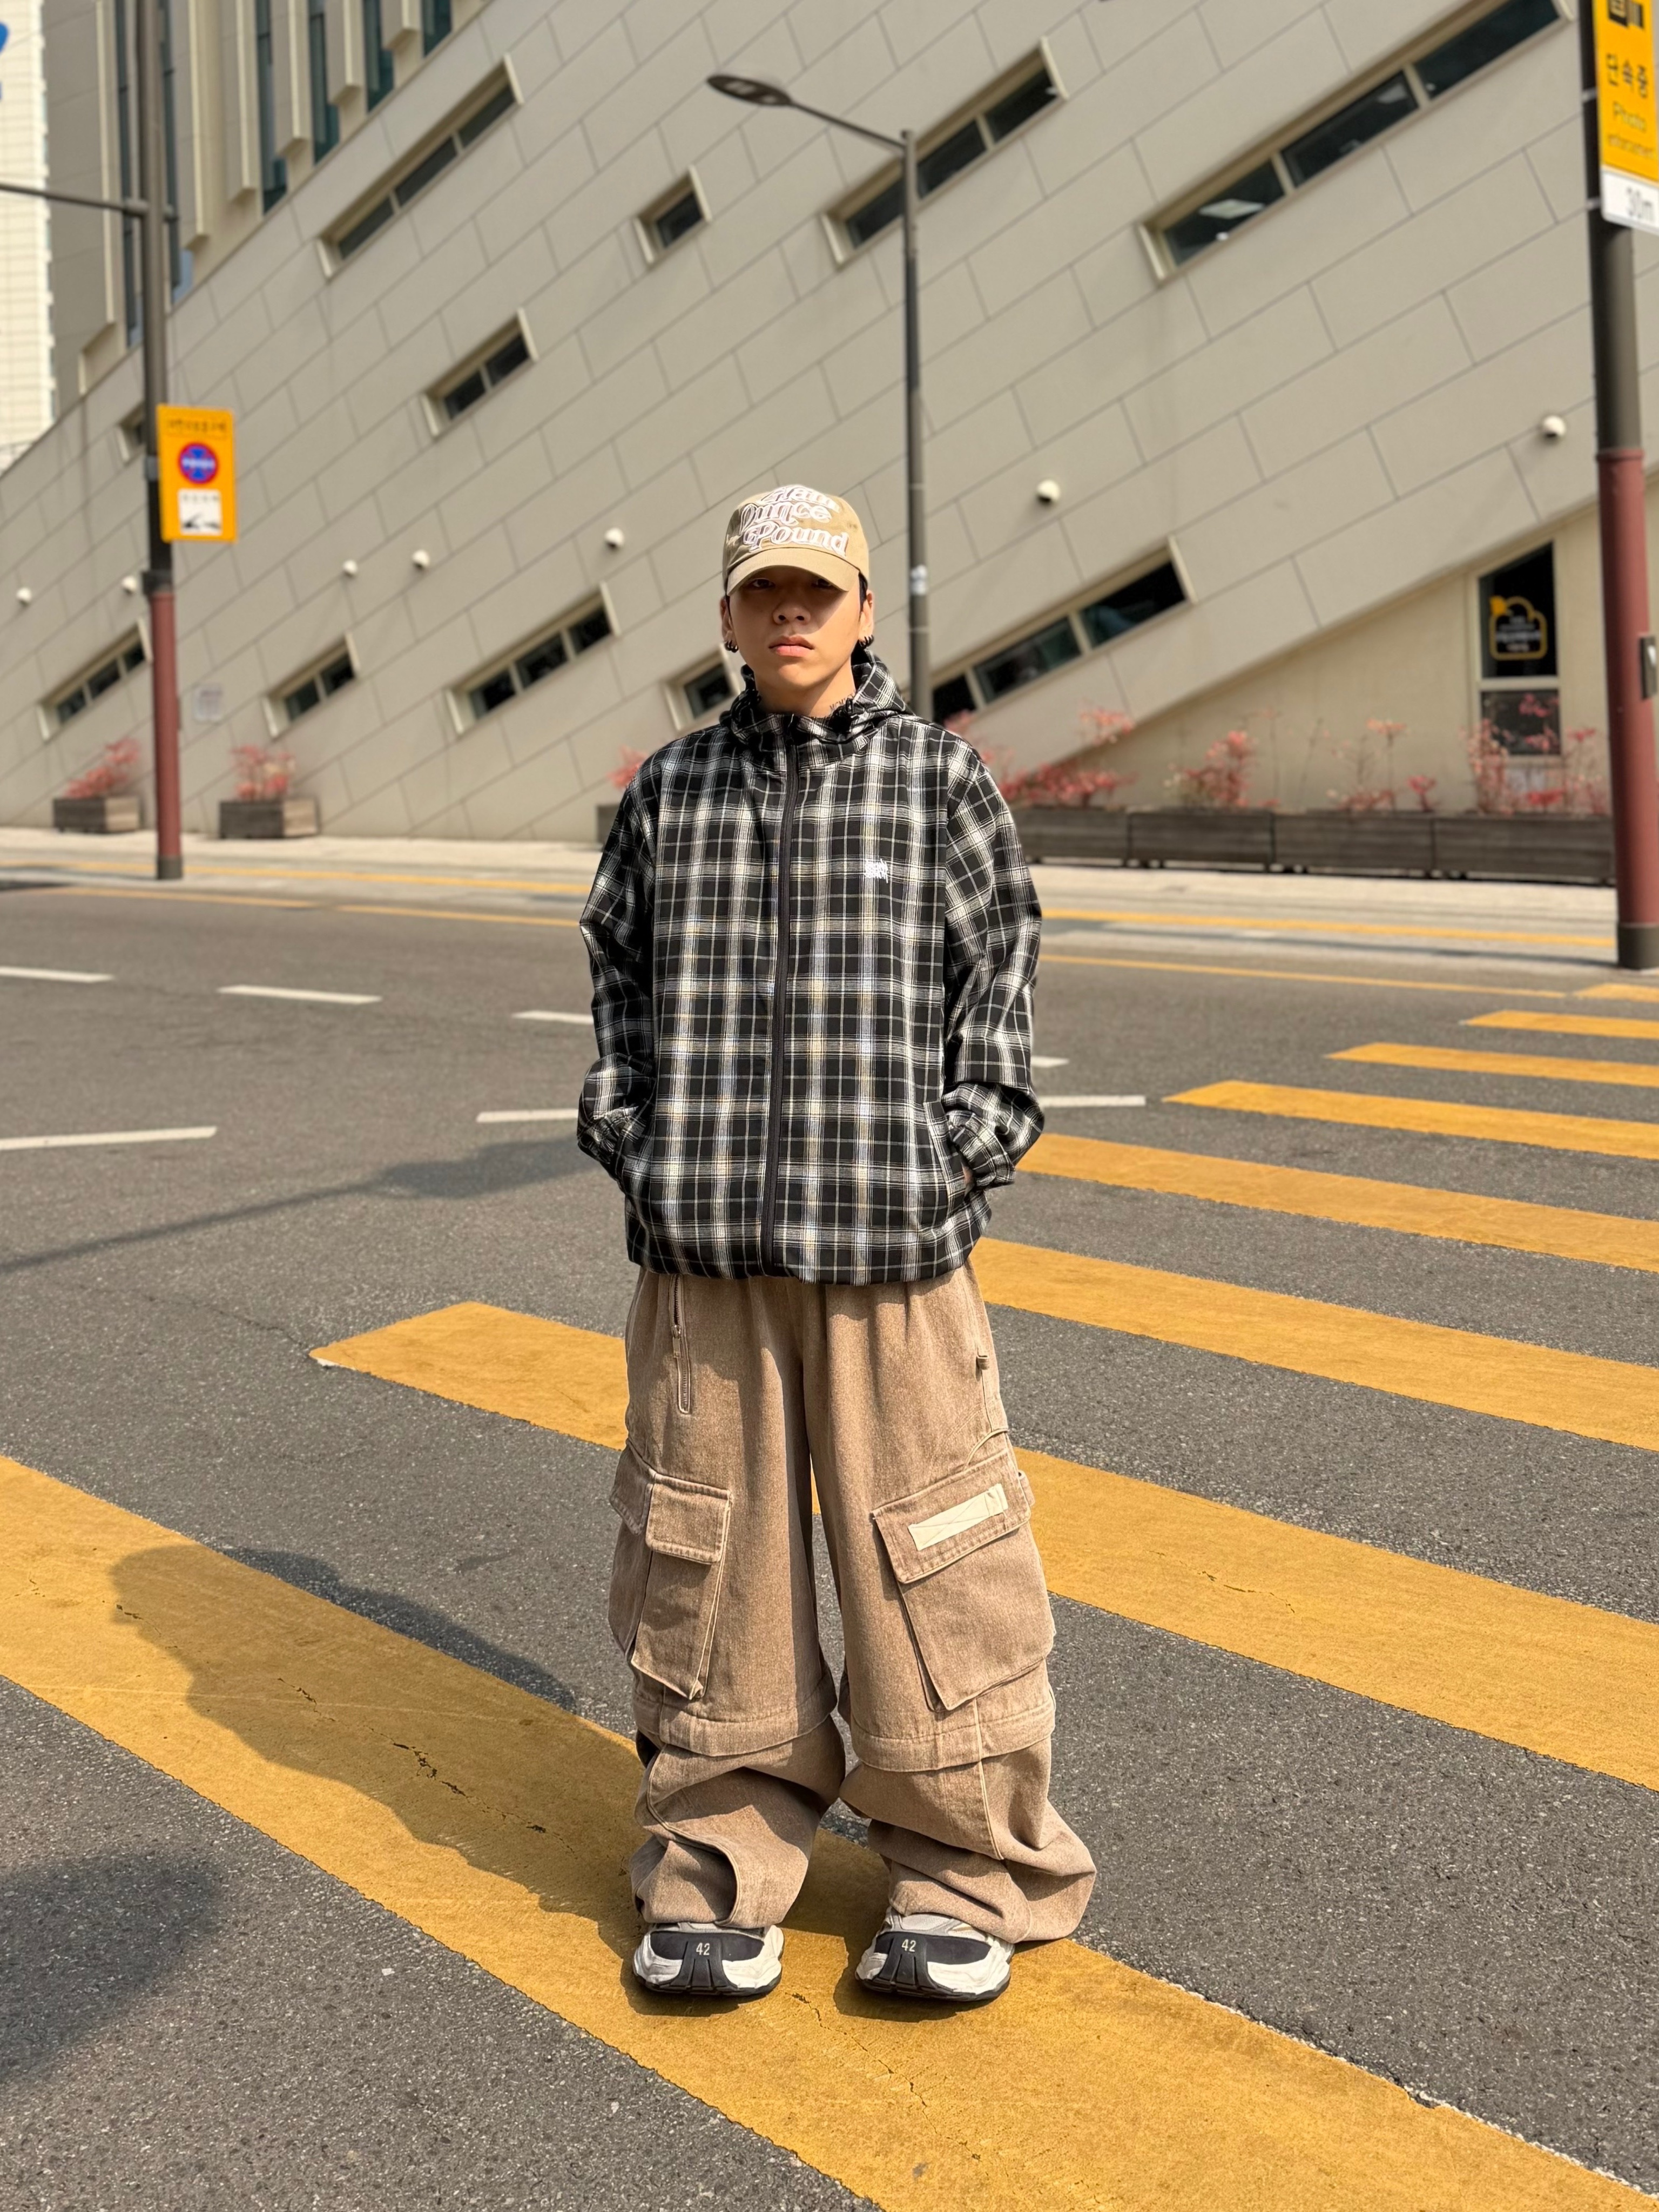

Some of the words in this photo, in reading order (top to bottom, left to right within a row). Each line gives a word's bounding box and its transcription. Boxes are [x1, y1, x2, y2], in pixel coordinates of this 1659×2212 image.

[744, 520, 849, 558] Pound
[696, 1942, 710, 1956] 42
[901, 1939, 916, 1952] 42
